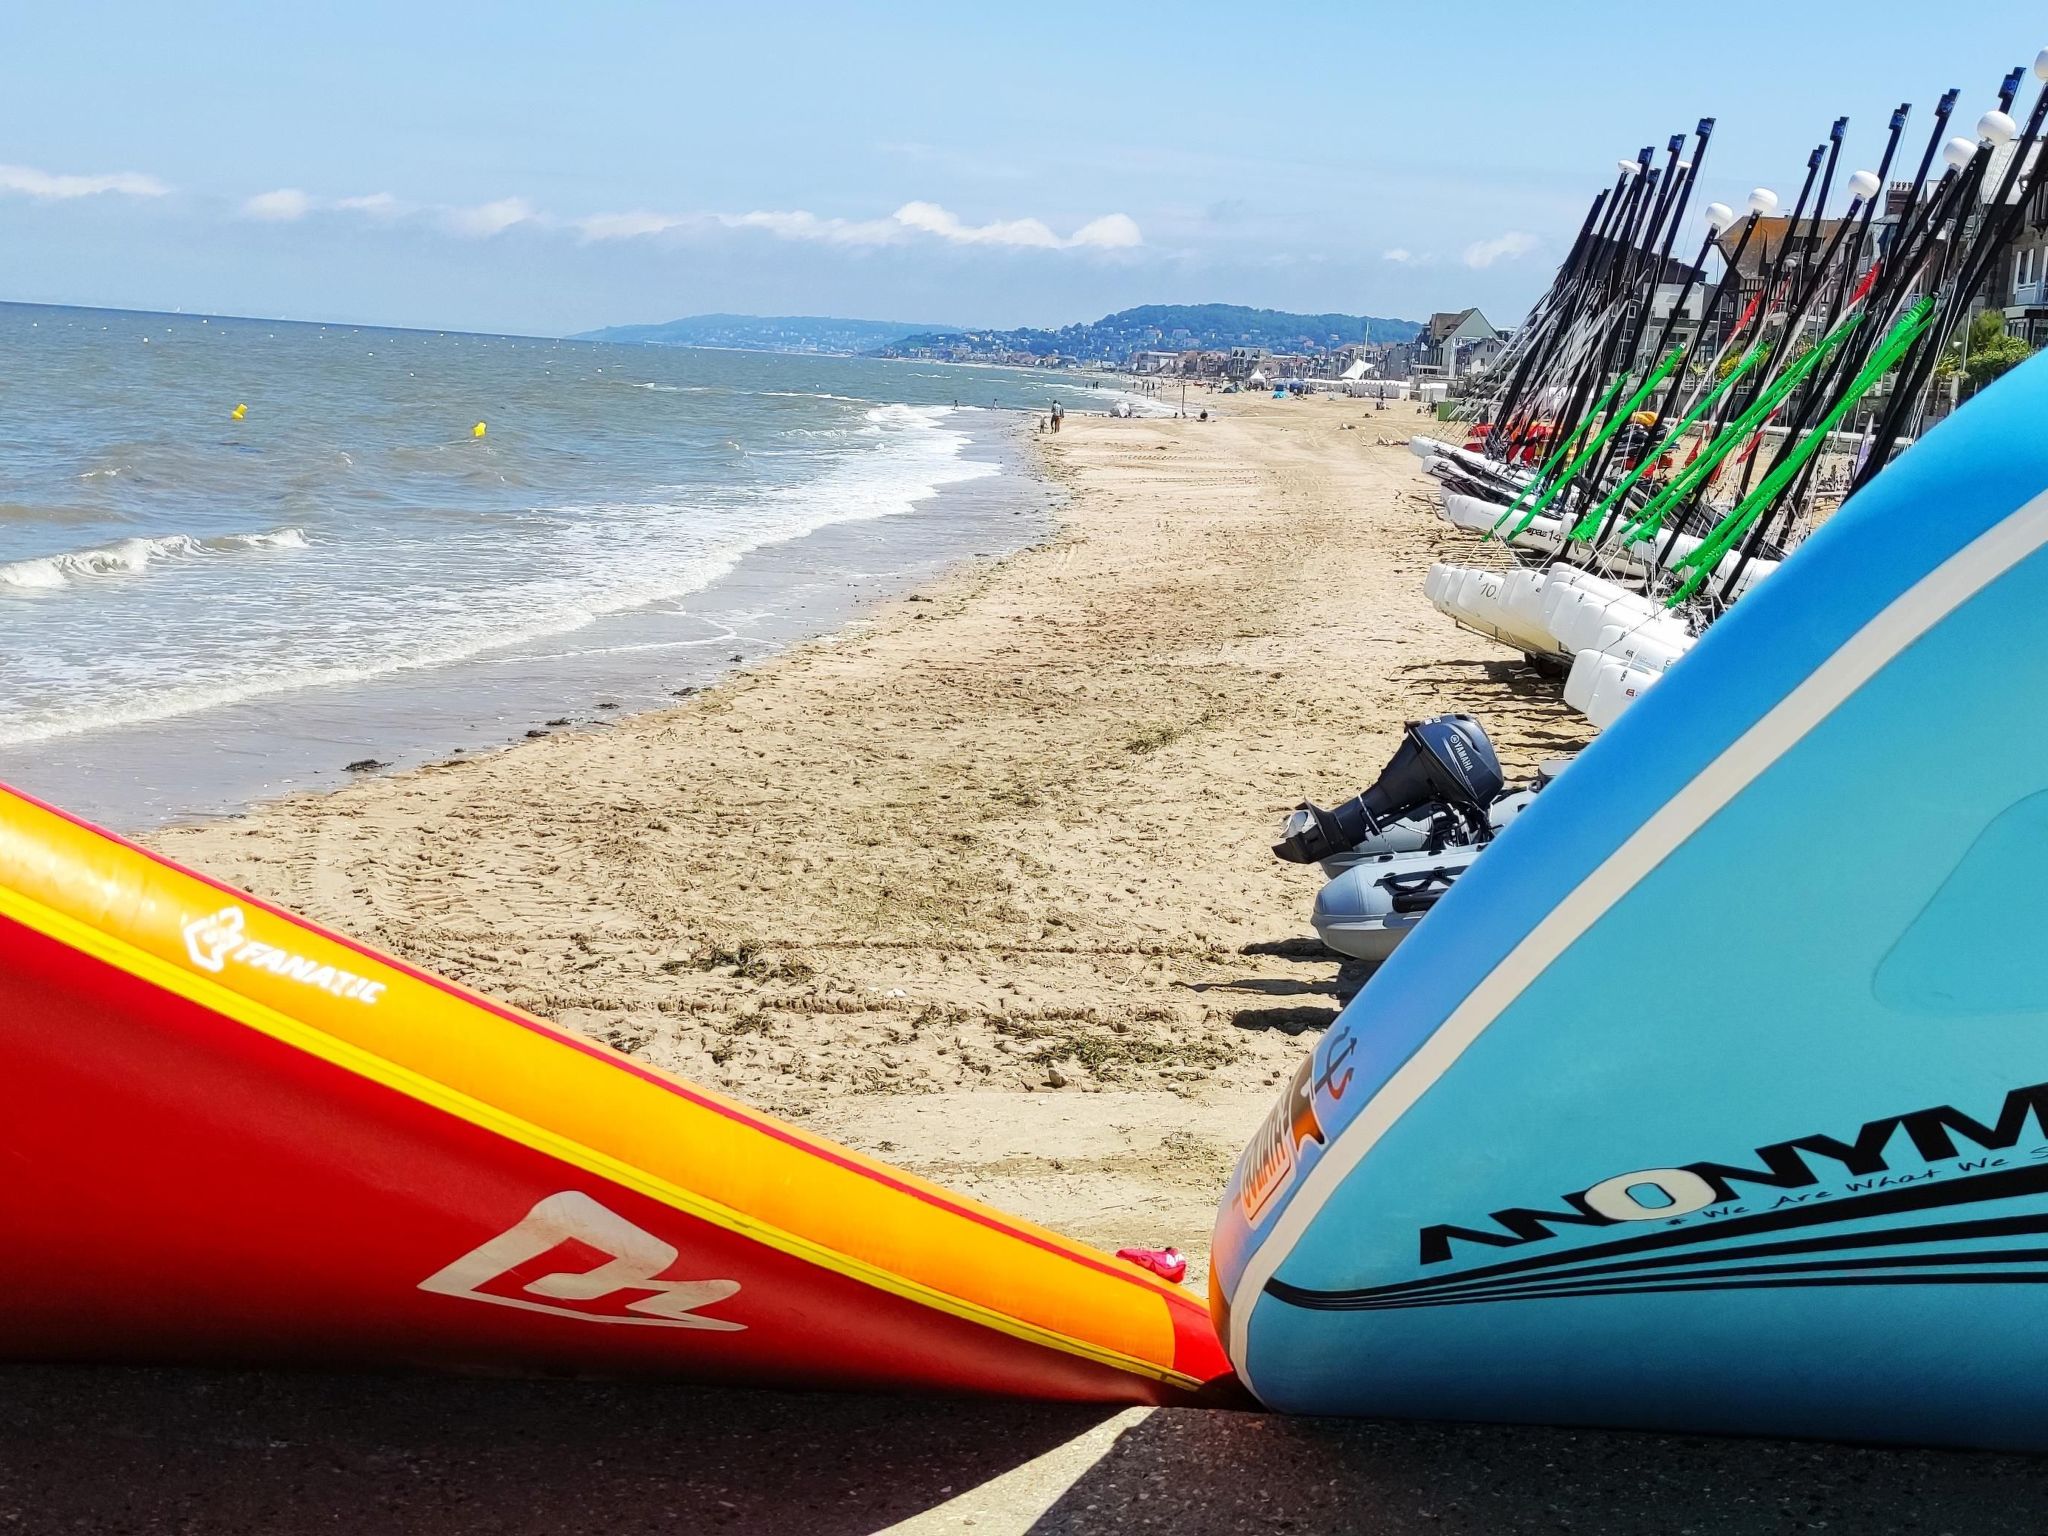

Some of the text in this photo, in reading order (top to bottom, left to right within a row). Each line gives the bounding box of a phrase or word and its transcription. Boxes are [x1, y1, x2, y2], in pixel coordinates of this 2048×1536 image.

[1454, 741, 1474, 772] YAMAHA
[233, 940, 387, 1004] FANATIC
[1702, 1206, 1750, 1218] We
[1768, 1190, 1833, 1210] Are
[1845, 1168, 1942, 1192] What
[1957, 1157, 2010, 1172] We
